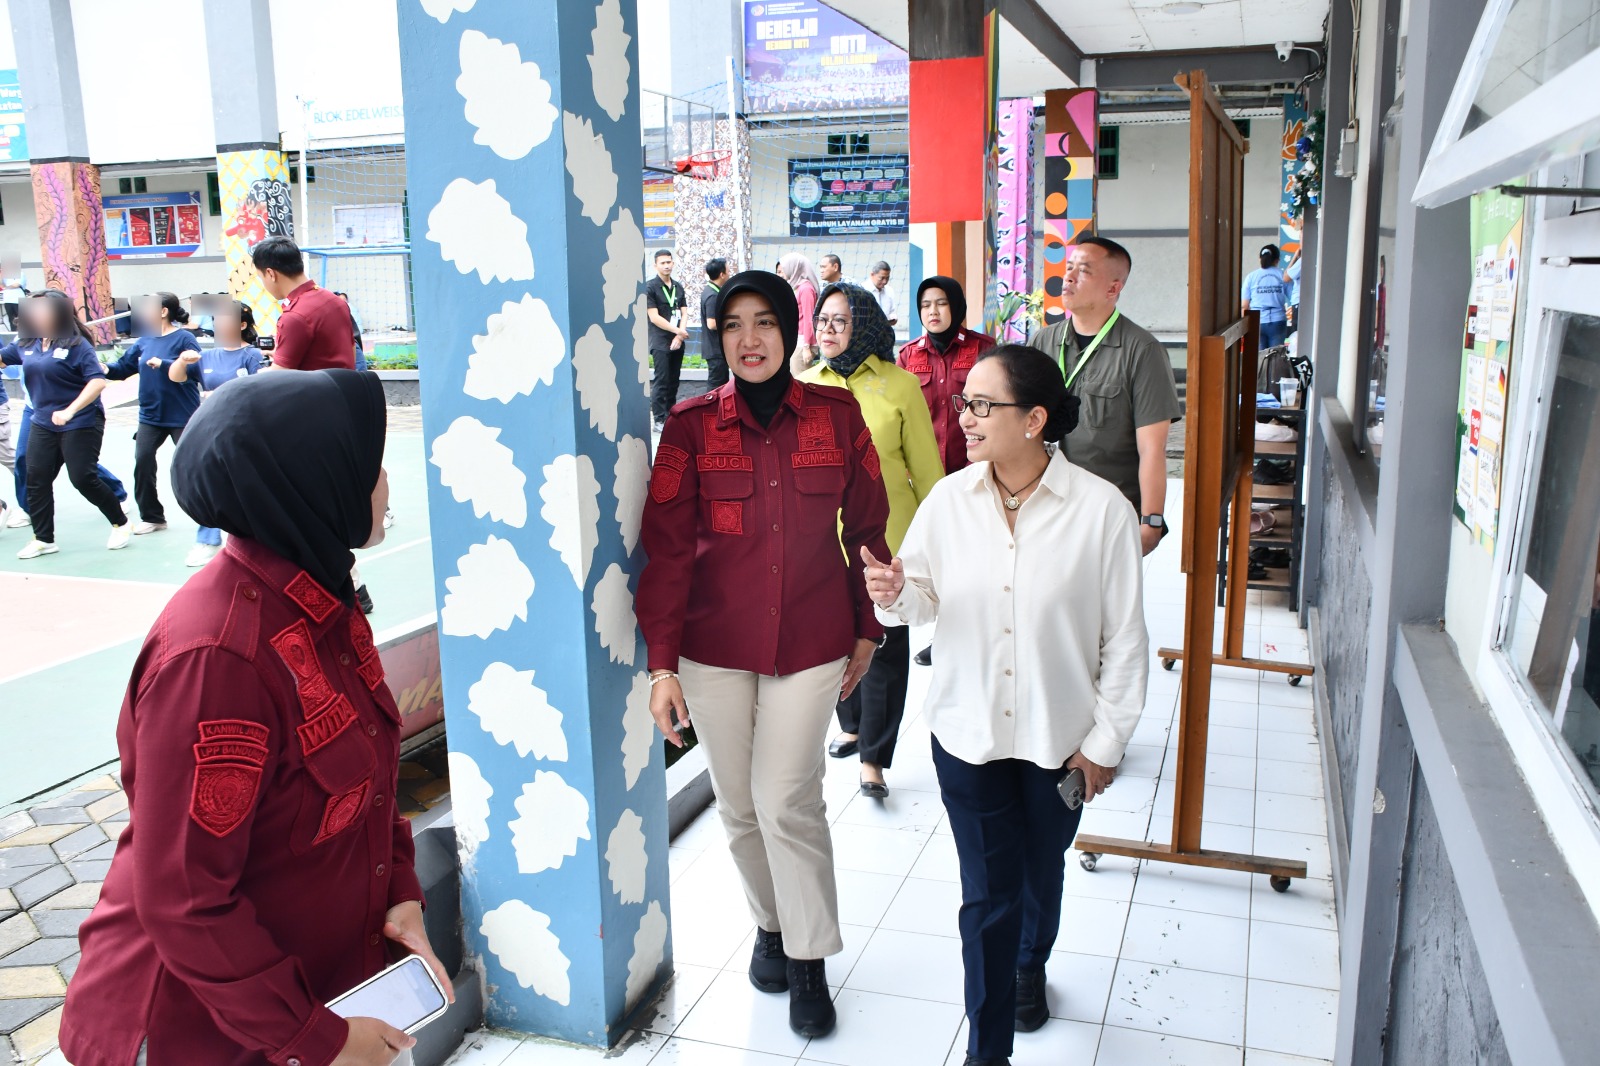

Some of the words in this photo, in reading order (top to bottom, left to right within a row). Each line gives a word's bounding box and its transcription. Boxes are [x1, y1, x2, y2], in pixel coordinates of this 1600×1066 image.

[314, 110, 342, 124] BLOK
[871, 218, 897, 226] GRATIS
[704, 457, 746, 469] SUCI
[794, 452, 842, 465] KUMHAM
[205, 724, 244, 736] KANWIL
[222, 745, 264, 760] BANDUNG
